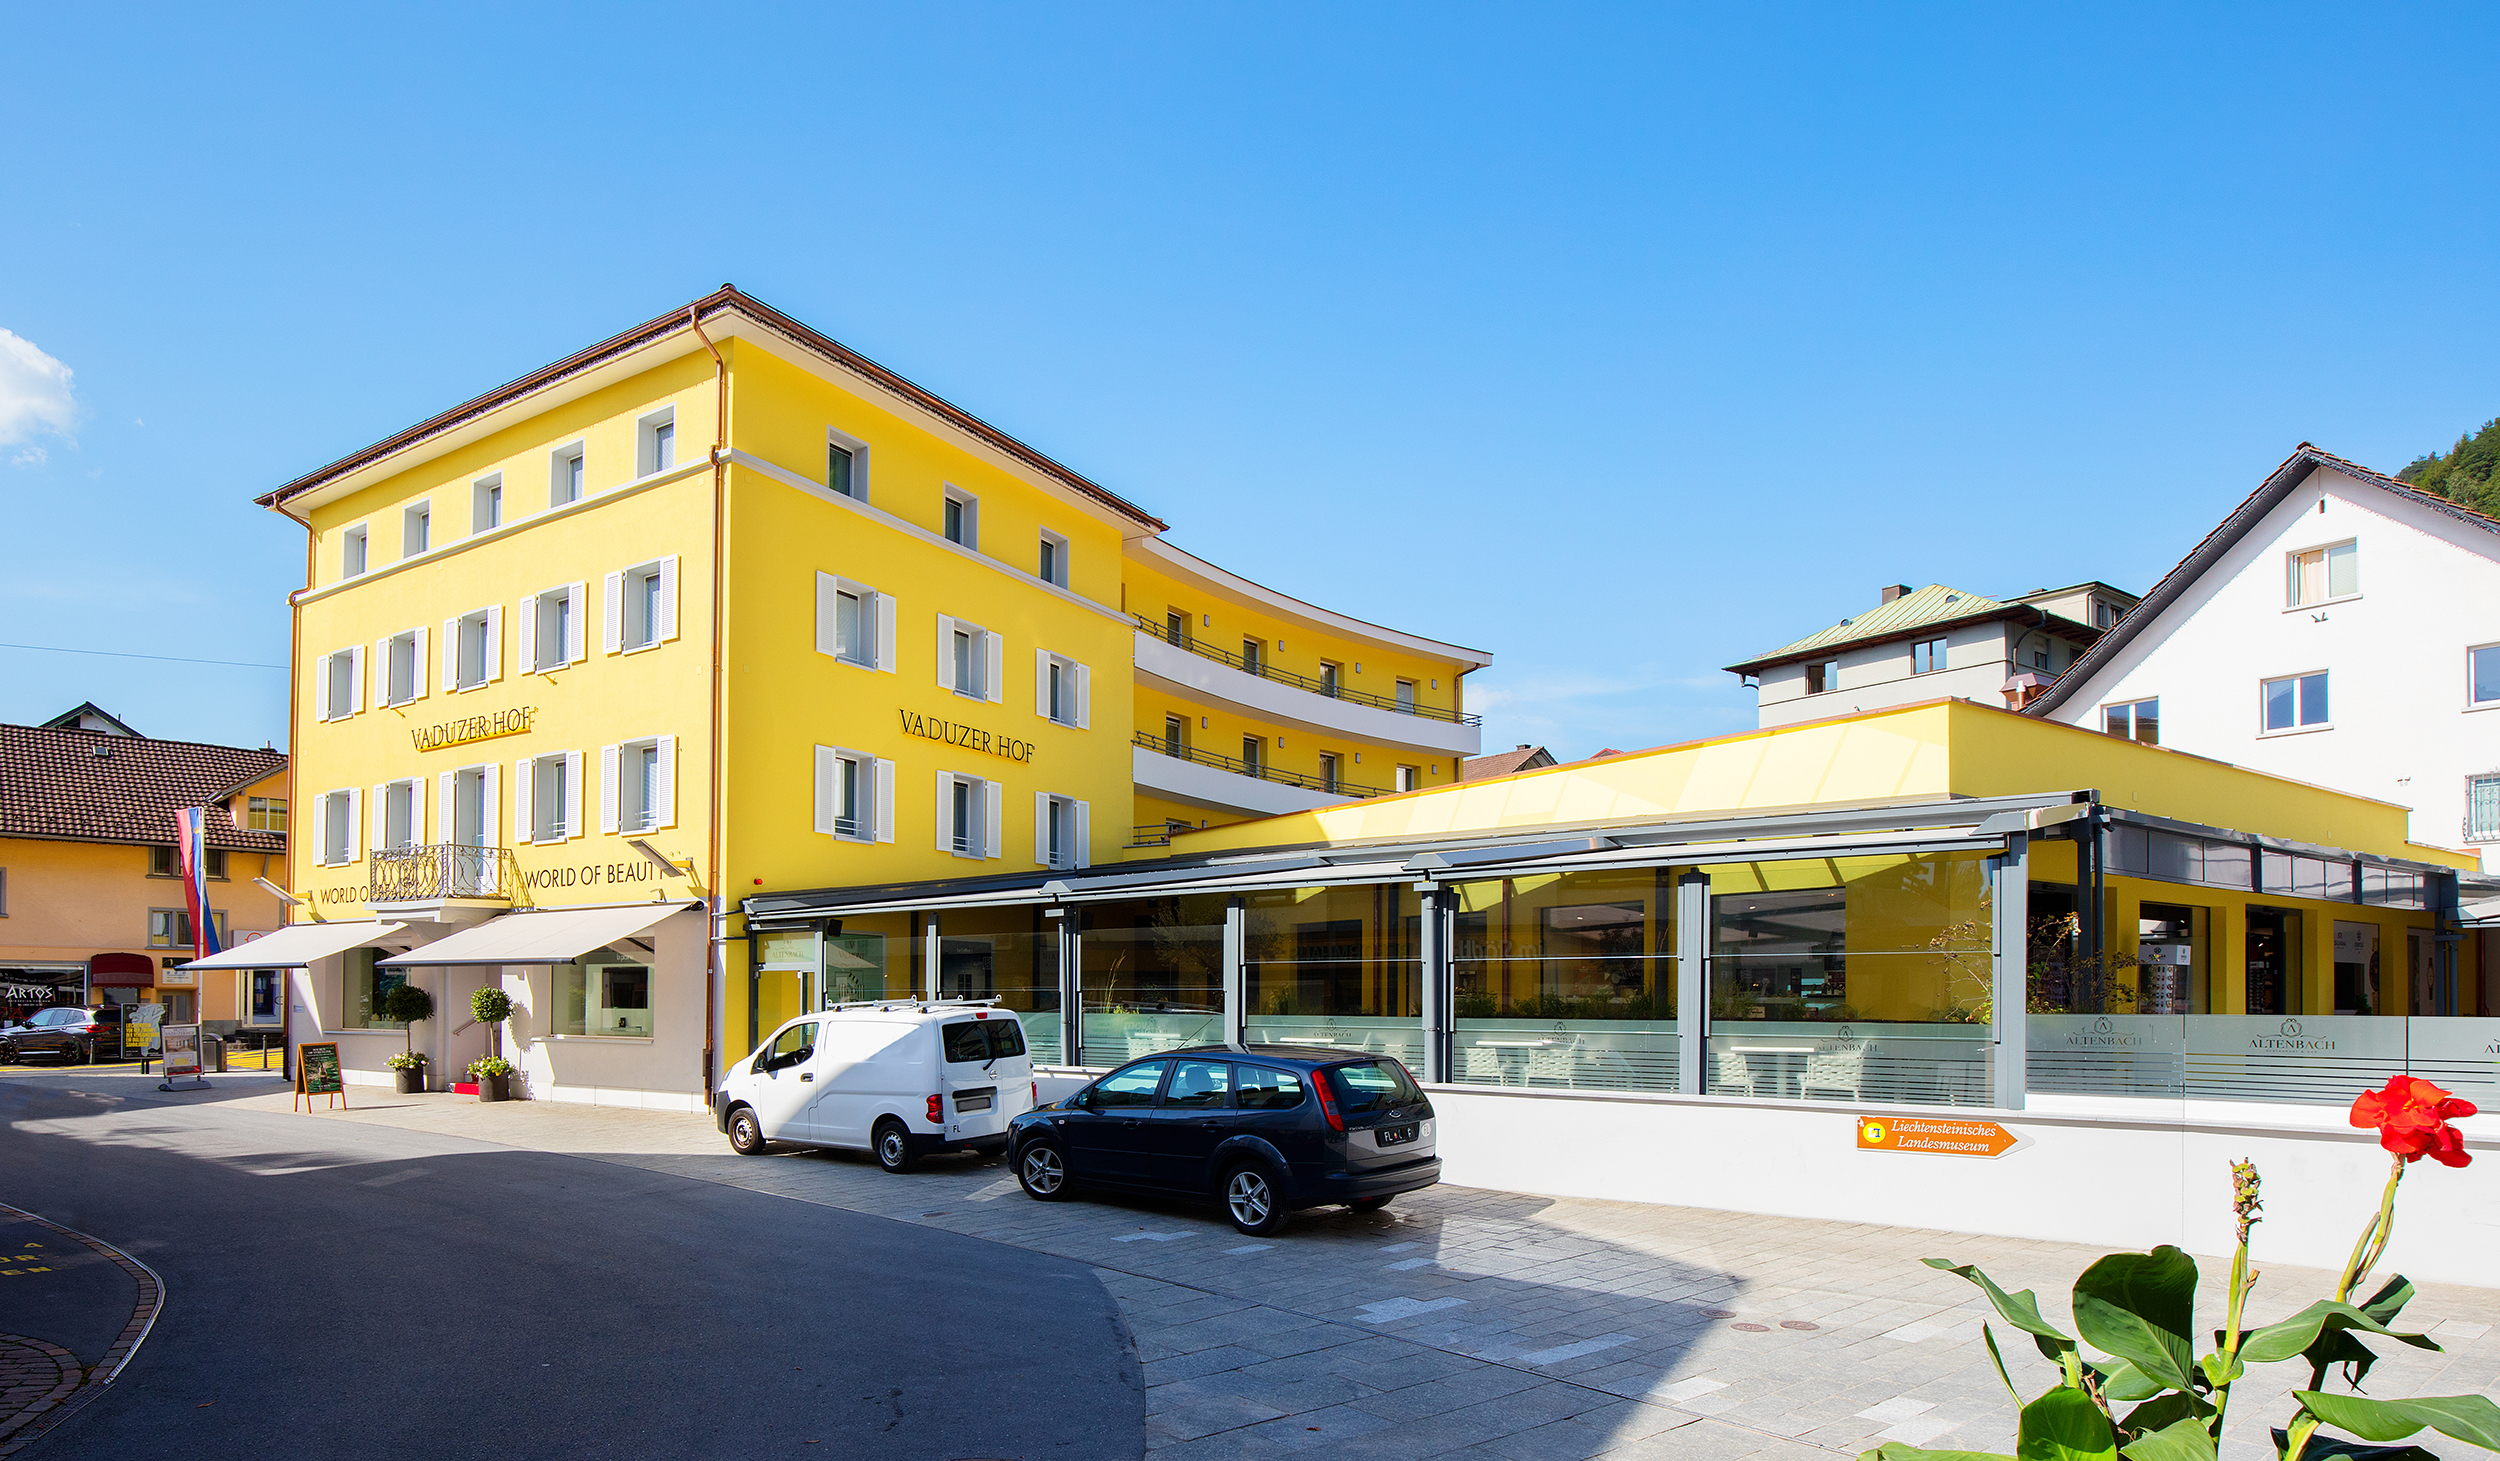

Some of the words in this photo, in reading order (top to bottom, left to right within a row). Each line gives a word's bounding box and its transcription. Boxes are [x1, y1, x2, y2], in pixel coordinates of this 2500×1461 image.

[411, 715, 488, 750] VADUZER
[493, 705, 531, 735] HOF
[899, 708, 993, 755] VADUZER
[997, 734, 1036, 764] HOF
[525, 867, 576, 889] WORLD
[580, 865, 601, 886] OF
[607, 861, 664, 884] BEAUT
[319, 886, 357, 905] WORLD
[359, 885, 369, 903] O
[5, 984, 53, 999] ARTOS
[2066, 1036, 2142, 1046] ALTENBACH
[2249, 1039, 2336, 1050] ALTENBACH
[952, 1124, 961, 1133] FL
[1423, 1125, 1430, 1135] FL
[1890, 1119, 1997, 1138] Liechtensteinisches
[1896, 1135, 1990, 1153] Landesmuseum
